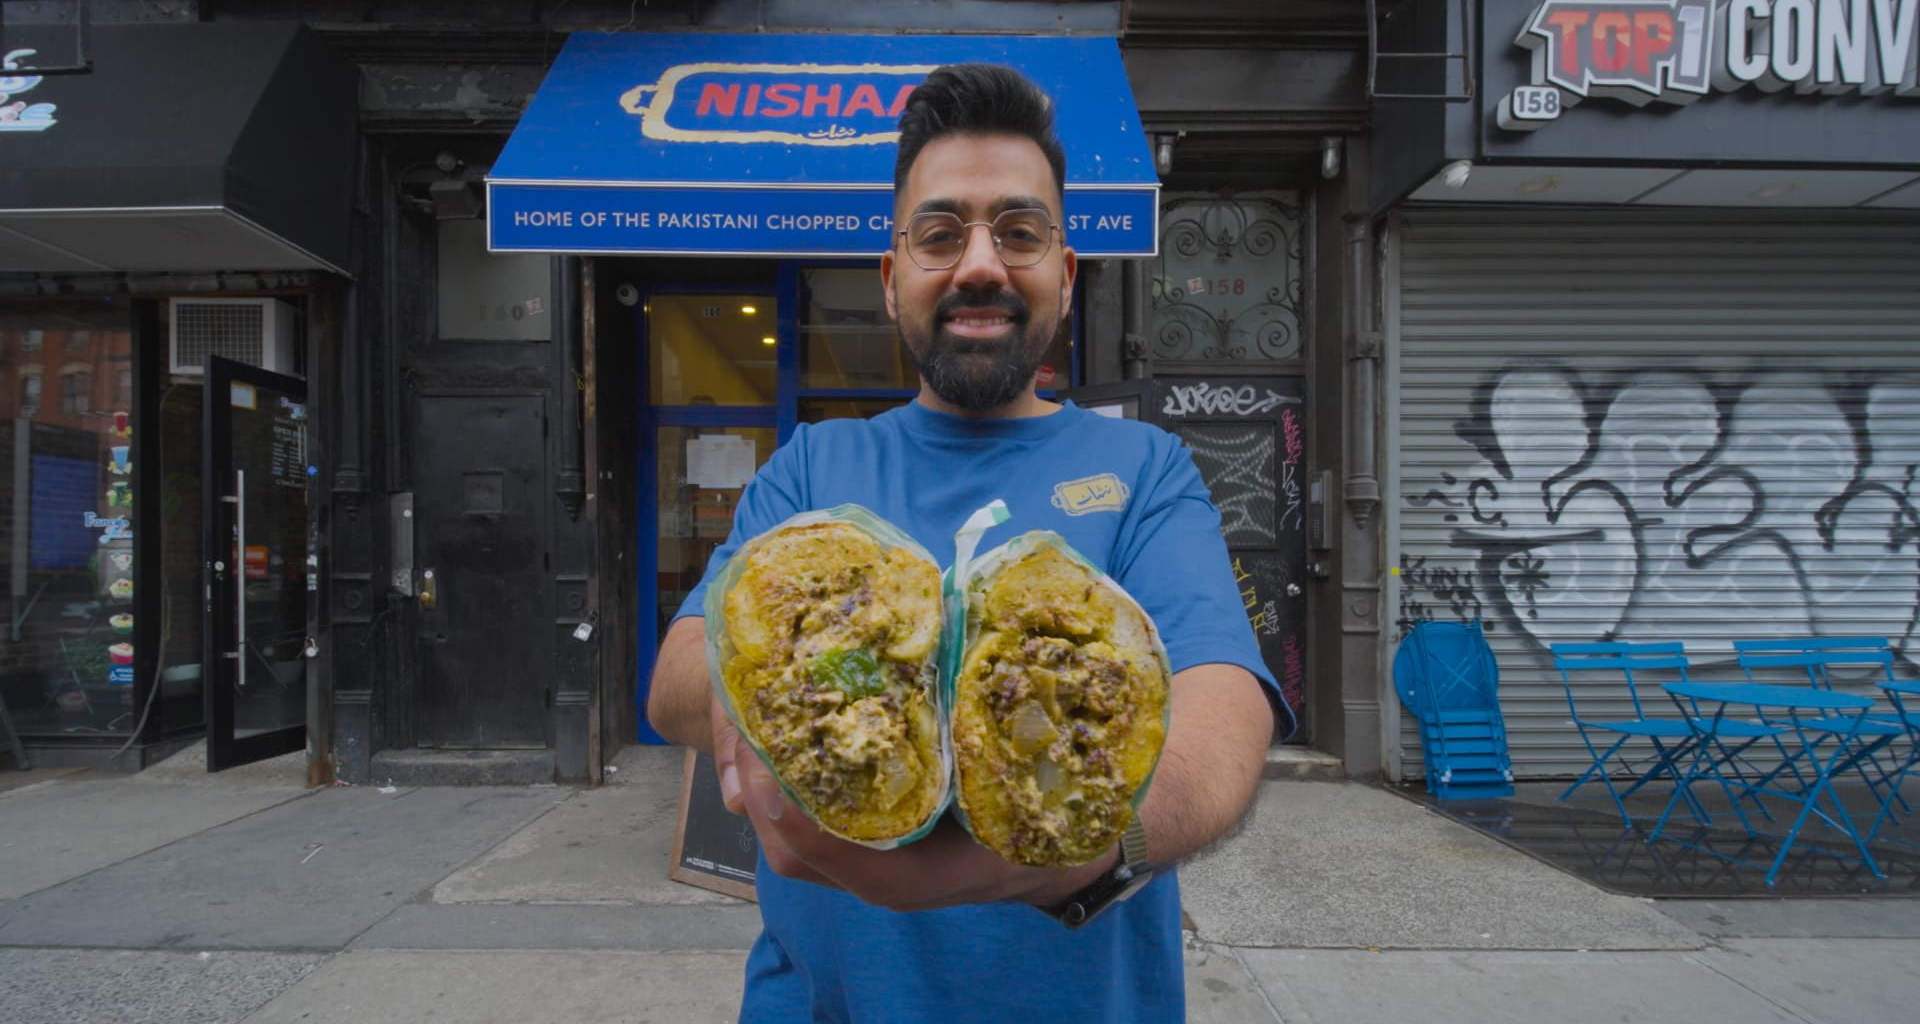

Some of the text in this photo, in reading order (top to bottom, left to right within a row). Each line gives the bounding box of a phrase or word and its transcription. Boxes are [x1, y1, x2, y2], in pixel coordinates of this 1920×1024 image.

[1728, 0, 1918, 85] CONV
[1516, 91, 1558, 114] 158
[514, 211, 572, 227] HOME
[580, 211, 607, 227] OF
[612, 212, 650, 228] THE
[658, 212, 758, 229] PAKISTANI
[766, 214, 860, 231] CHOPPED
[1096, 215, 1132, 230] AVE
[1207, 278, 1245, 295] 158
